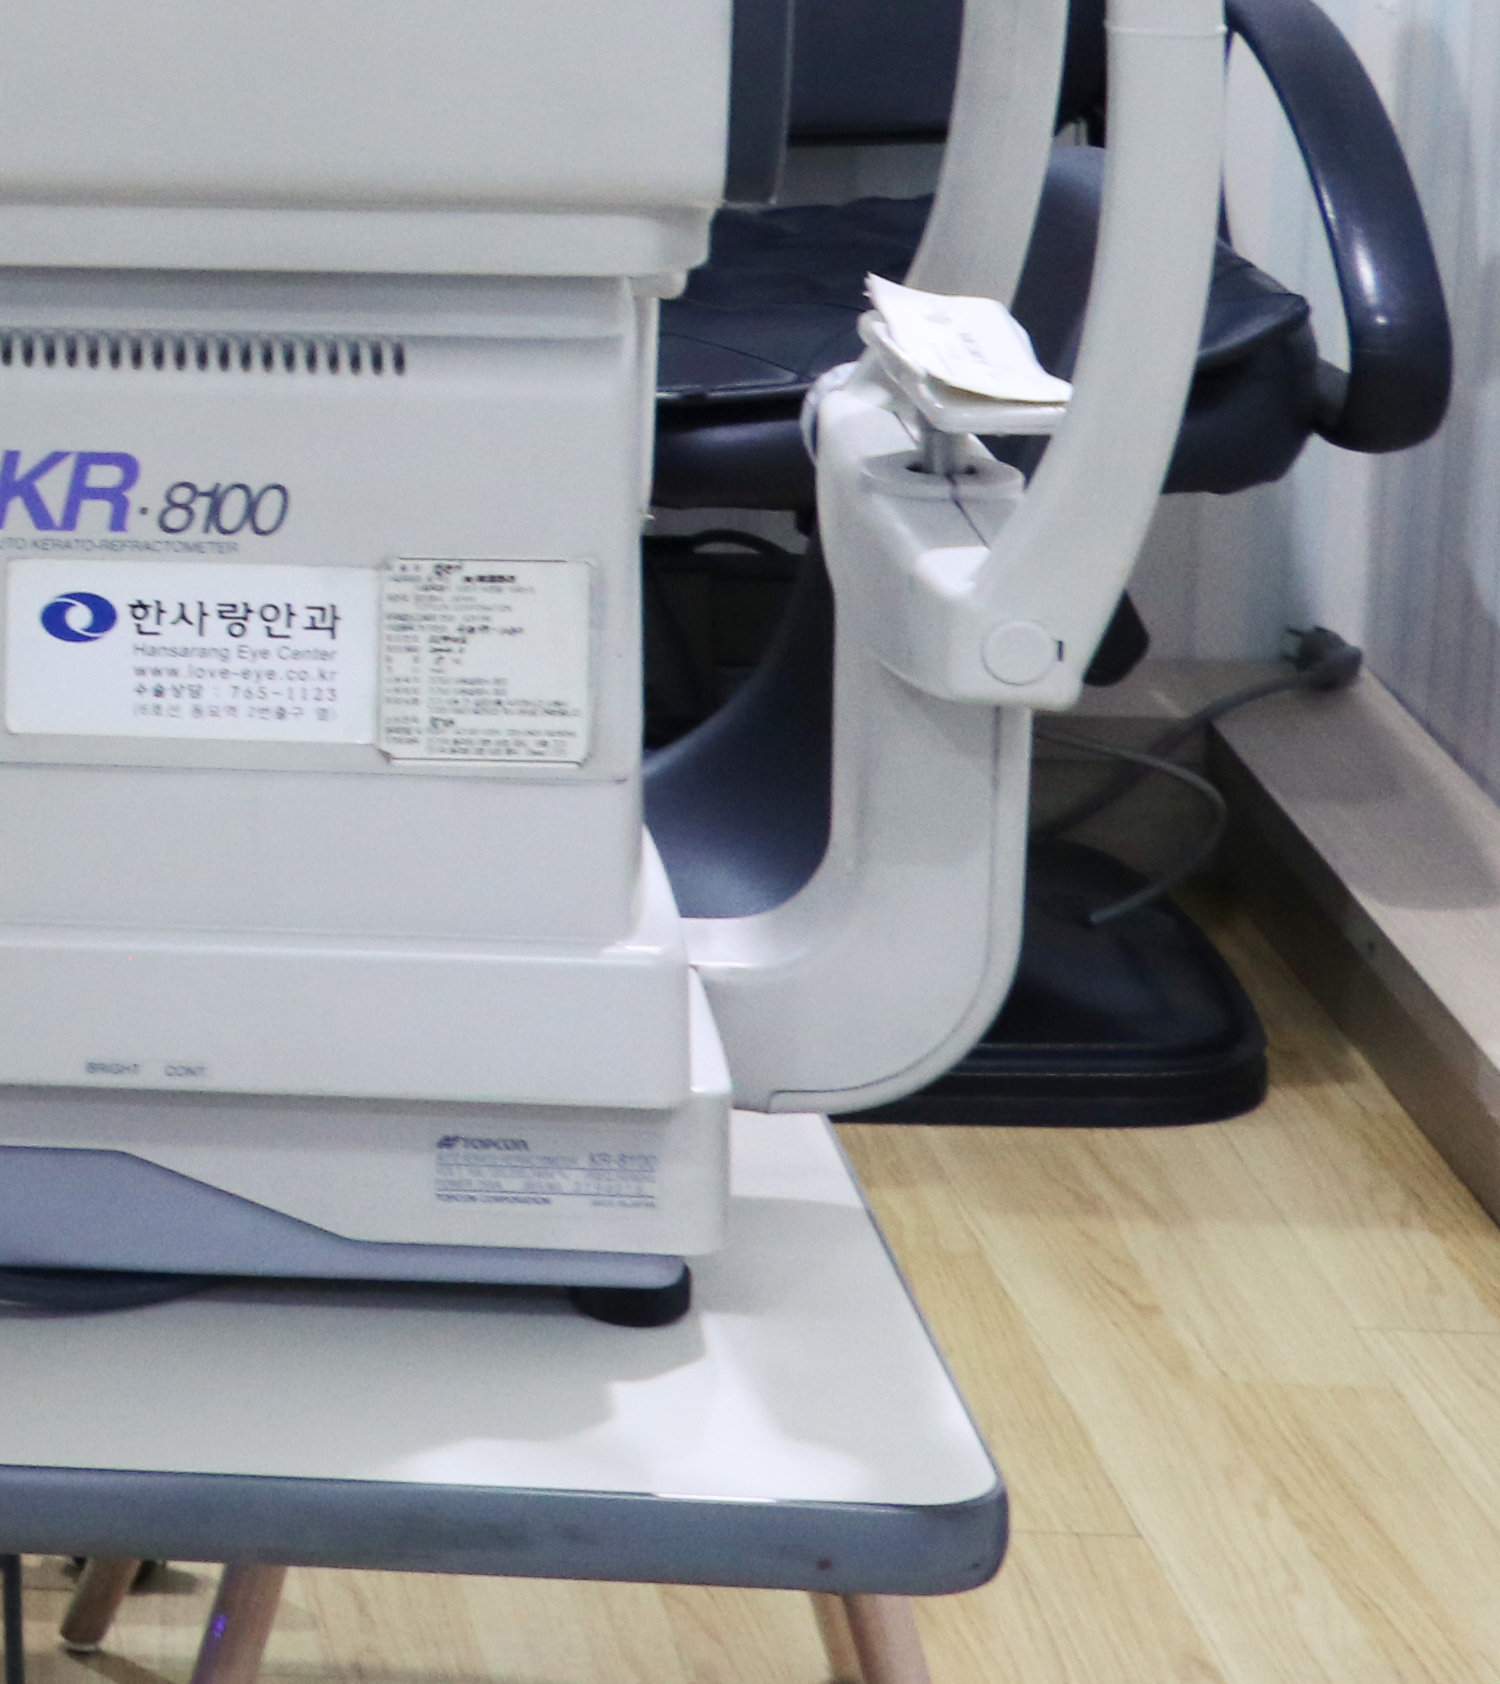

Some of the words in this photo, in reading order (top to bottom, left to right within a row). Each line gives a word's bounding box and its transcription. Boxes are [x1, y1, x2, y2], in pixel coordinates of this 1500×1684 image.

[128, 599, 342, 640] 한사랑안과
[133, 644, 230, 662] Hansarang
[236, 644, 270, 663] Eye
[276, 645, 338, 661] Center
[133, 665, 338, 682] www.love-eye.co.kr
[134, 683, 203, 699] 수술상담
[230, 685, 338, 702] 765-1123
[462, 1136, 529, 1151] TOPCON
